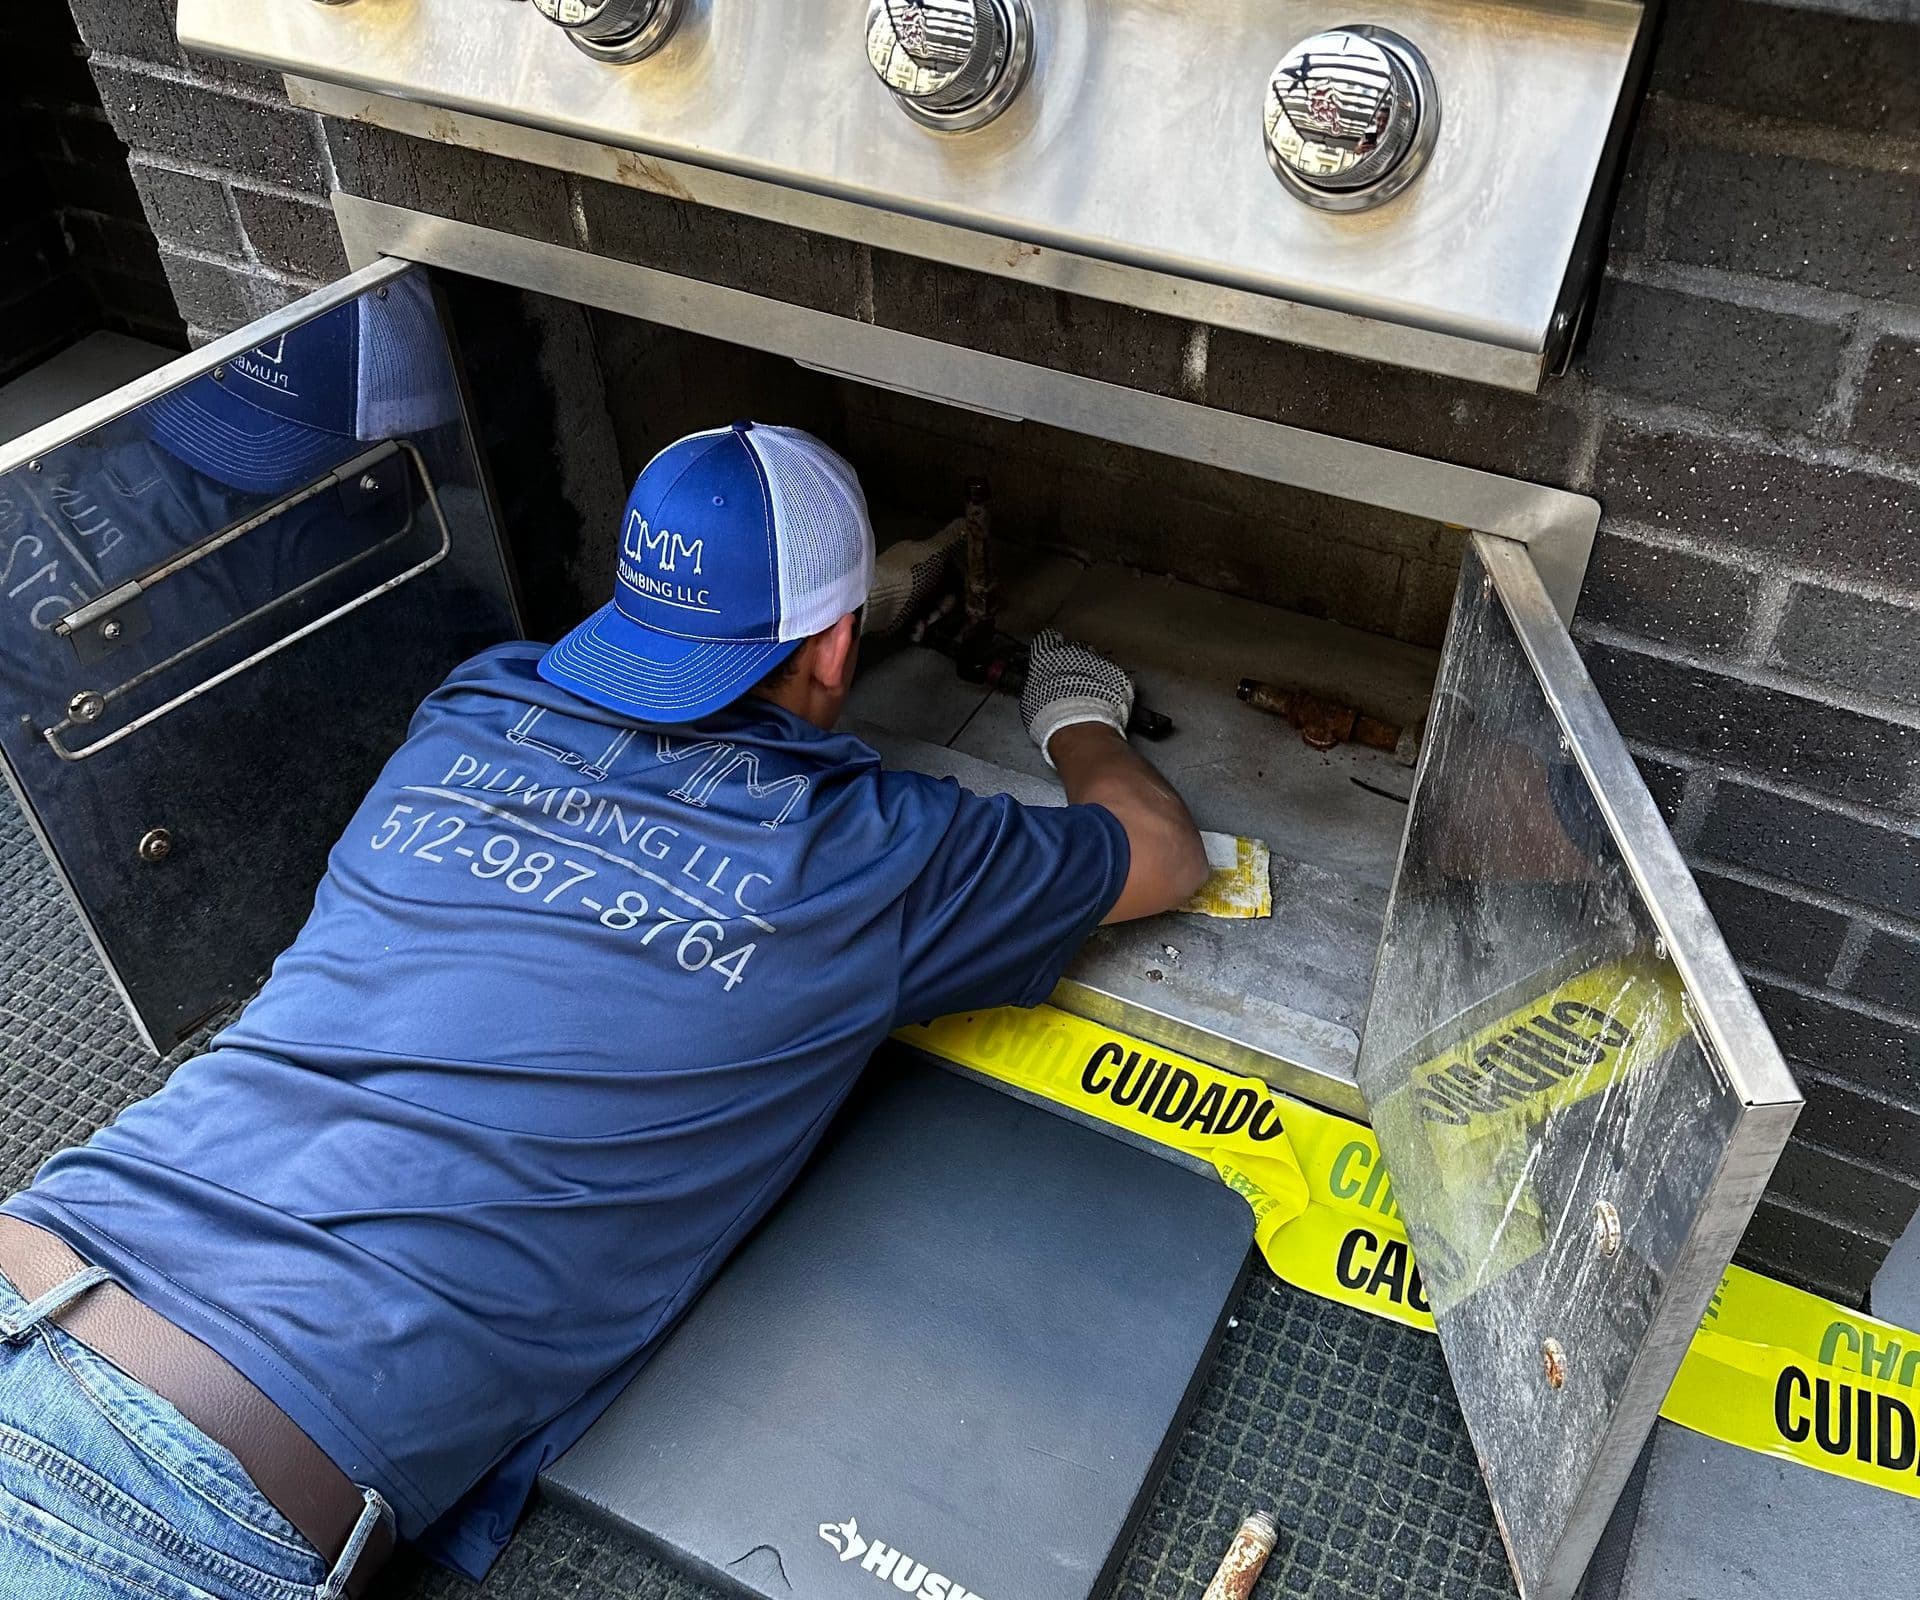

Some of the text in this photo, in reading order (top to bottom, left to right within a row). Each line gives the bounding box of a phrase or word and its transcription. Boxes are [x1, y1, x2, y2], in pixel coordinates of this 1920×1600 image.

[619, 557, 710, 606] PLUMBING LLC
[440, 753, 772, 912] PLUMBING LLC
[370, 804, 758, 993] 512-987-8764
[1080, 1041, 1285, 1142] CUIDADO
[1774, 1364, 1920, 1478] CUID
